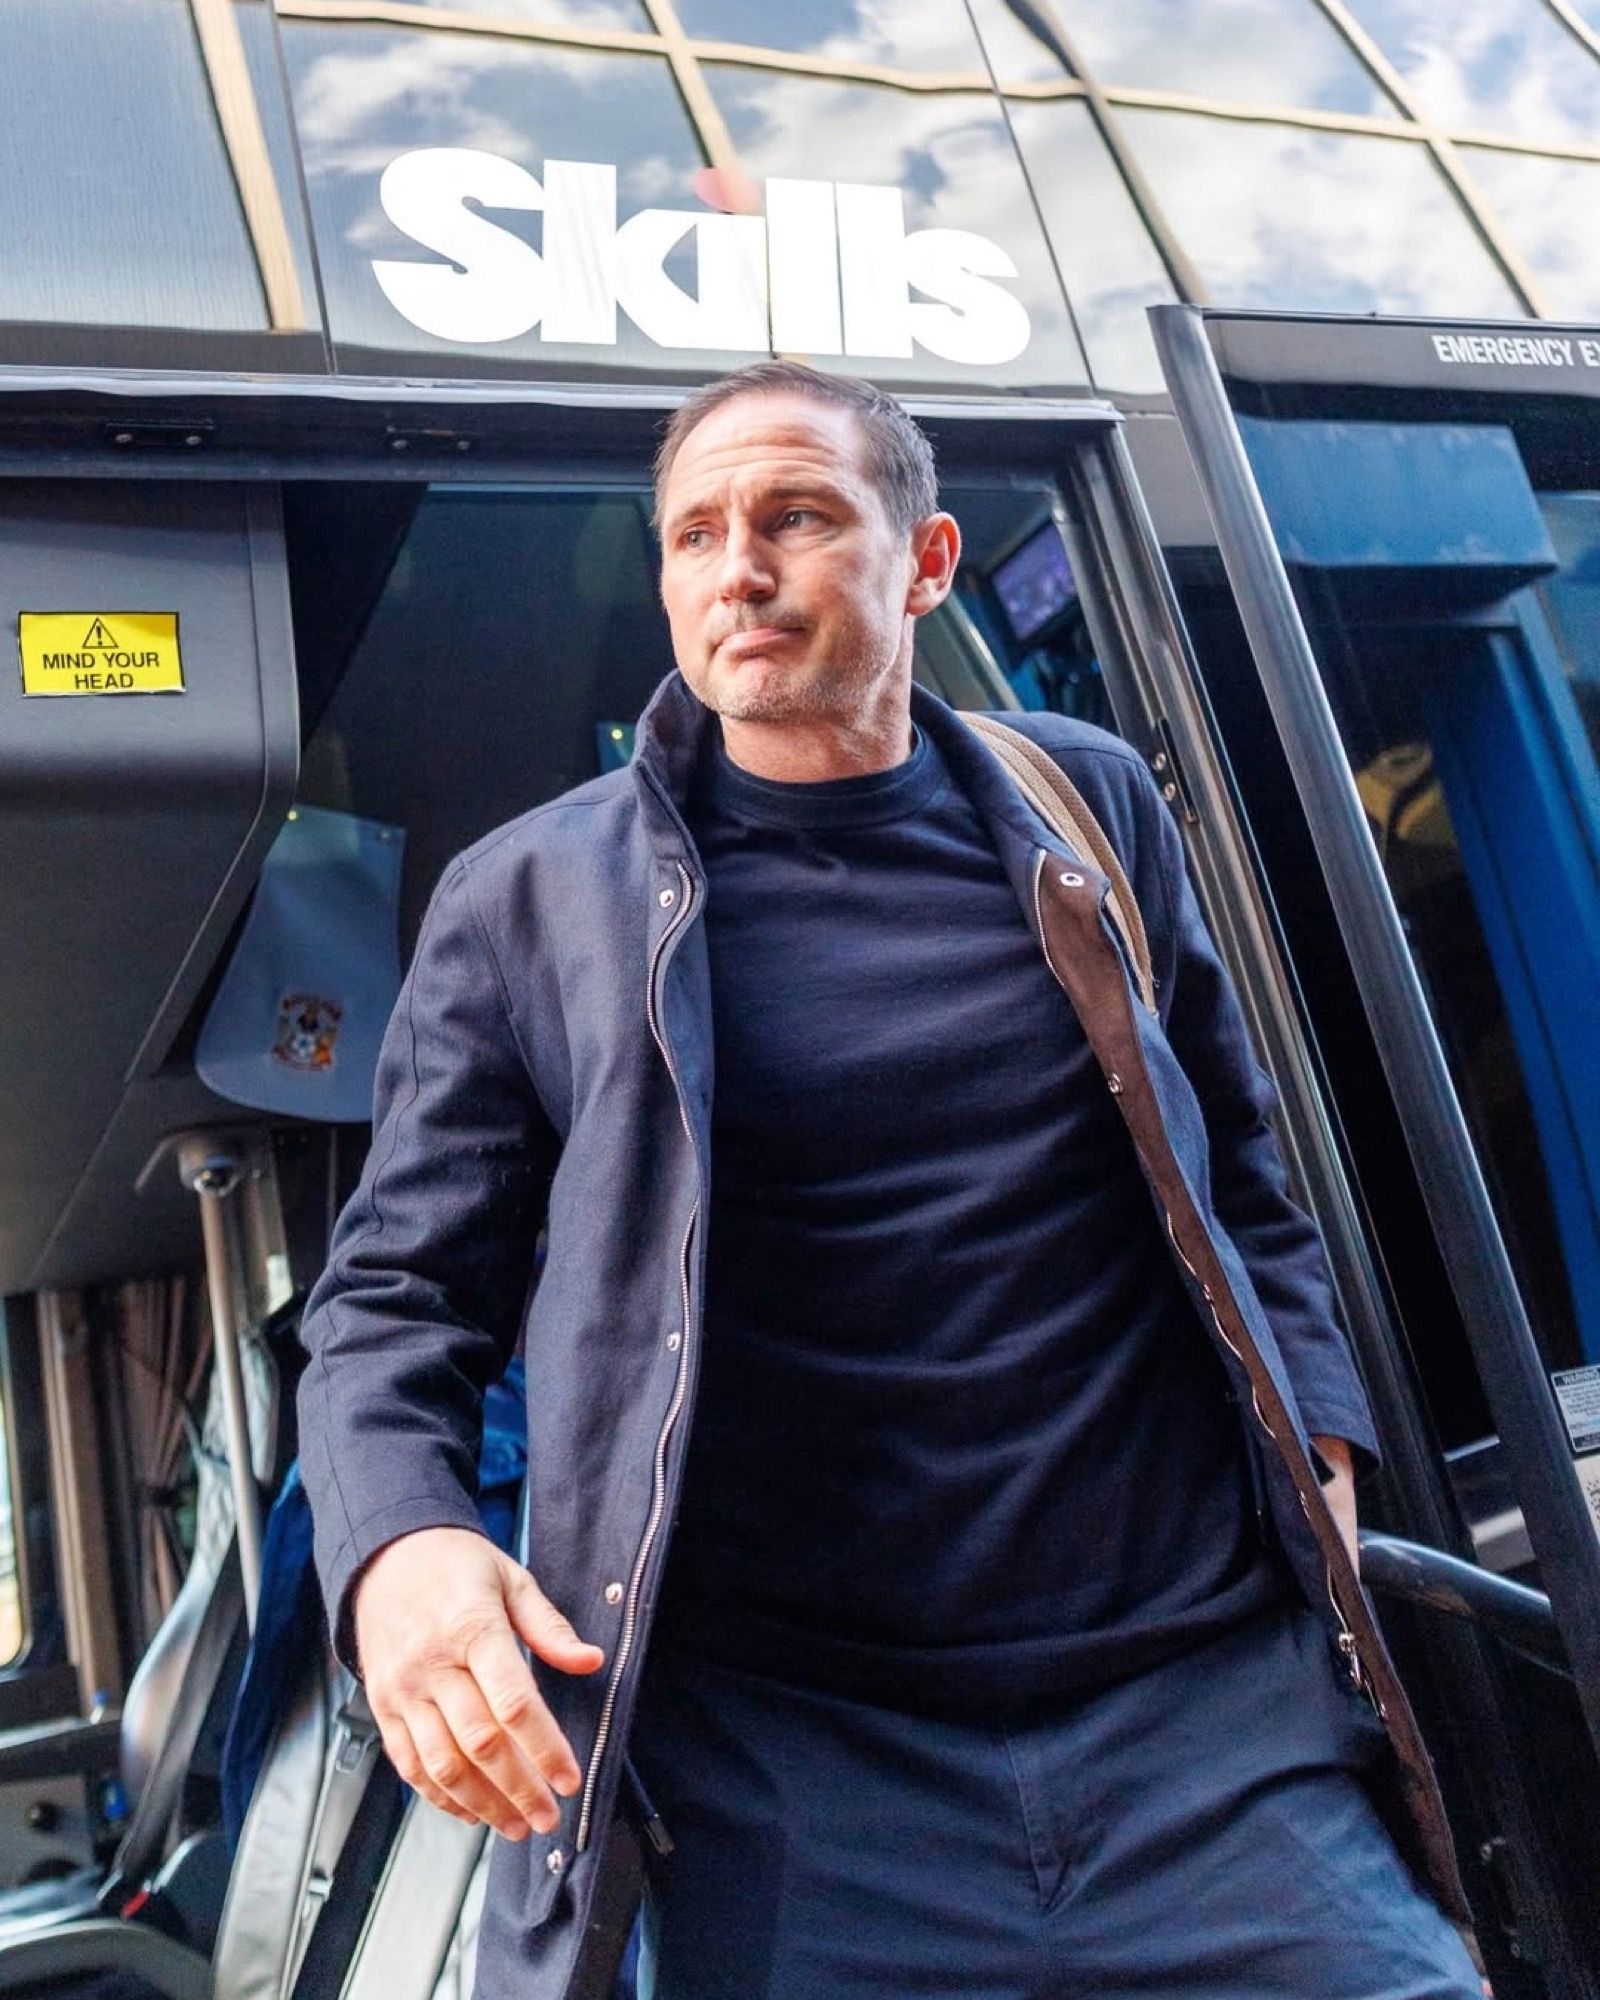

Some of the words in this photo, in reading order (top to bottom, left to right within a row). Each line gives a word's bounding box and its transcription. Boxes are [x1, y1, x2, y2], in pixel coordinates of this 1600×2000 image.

[372, 148, 1030, 365] Skills
[1431, 335, 1574, 366] EMERGENCY
[42, 652, 96, 670] MIND
[102, 651, 160, 668] YOUR
[74, 673, 134, 690] HEAD
